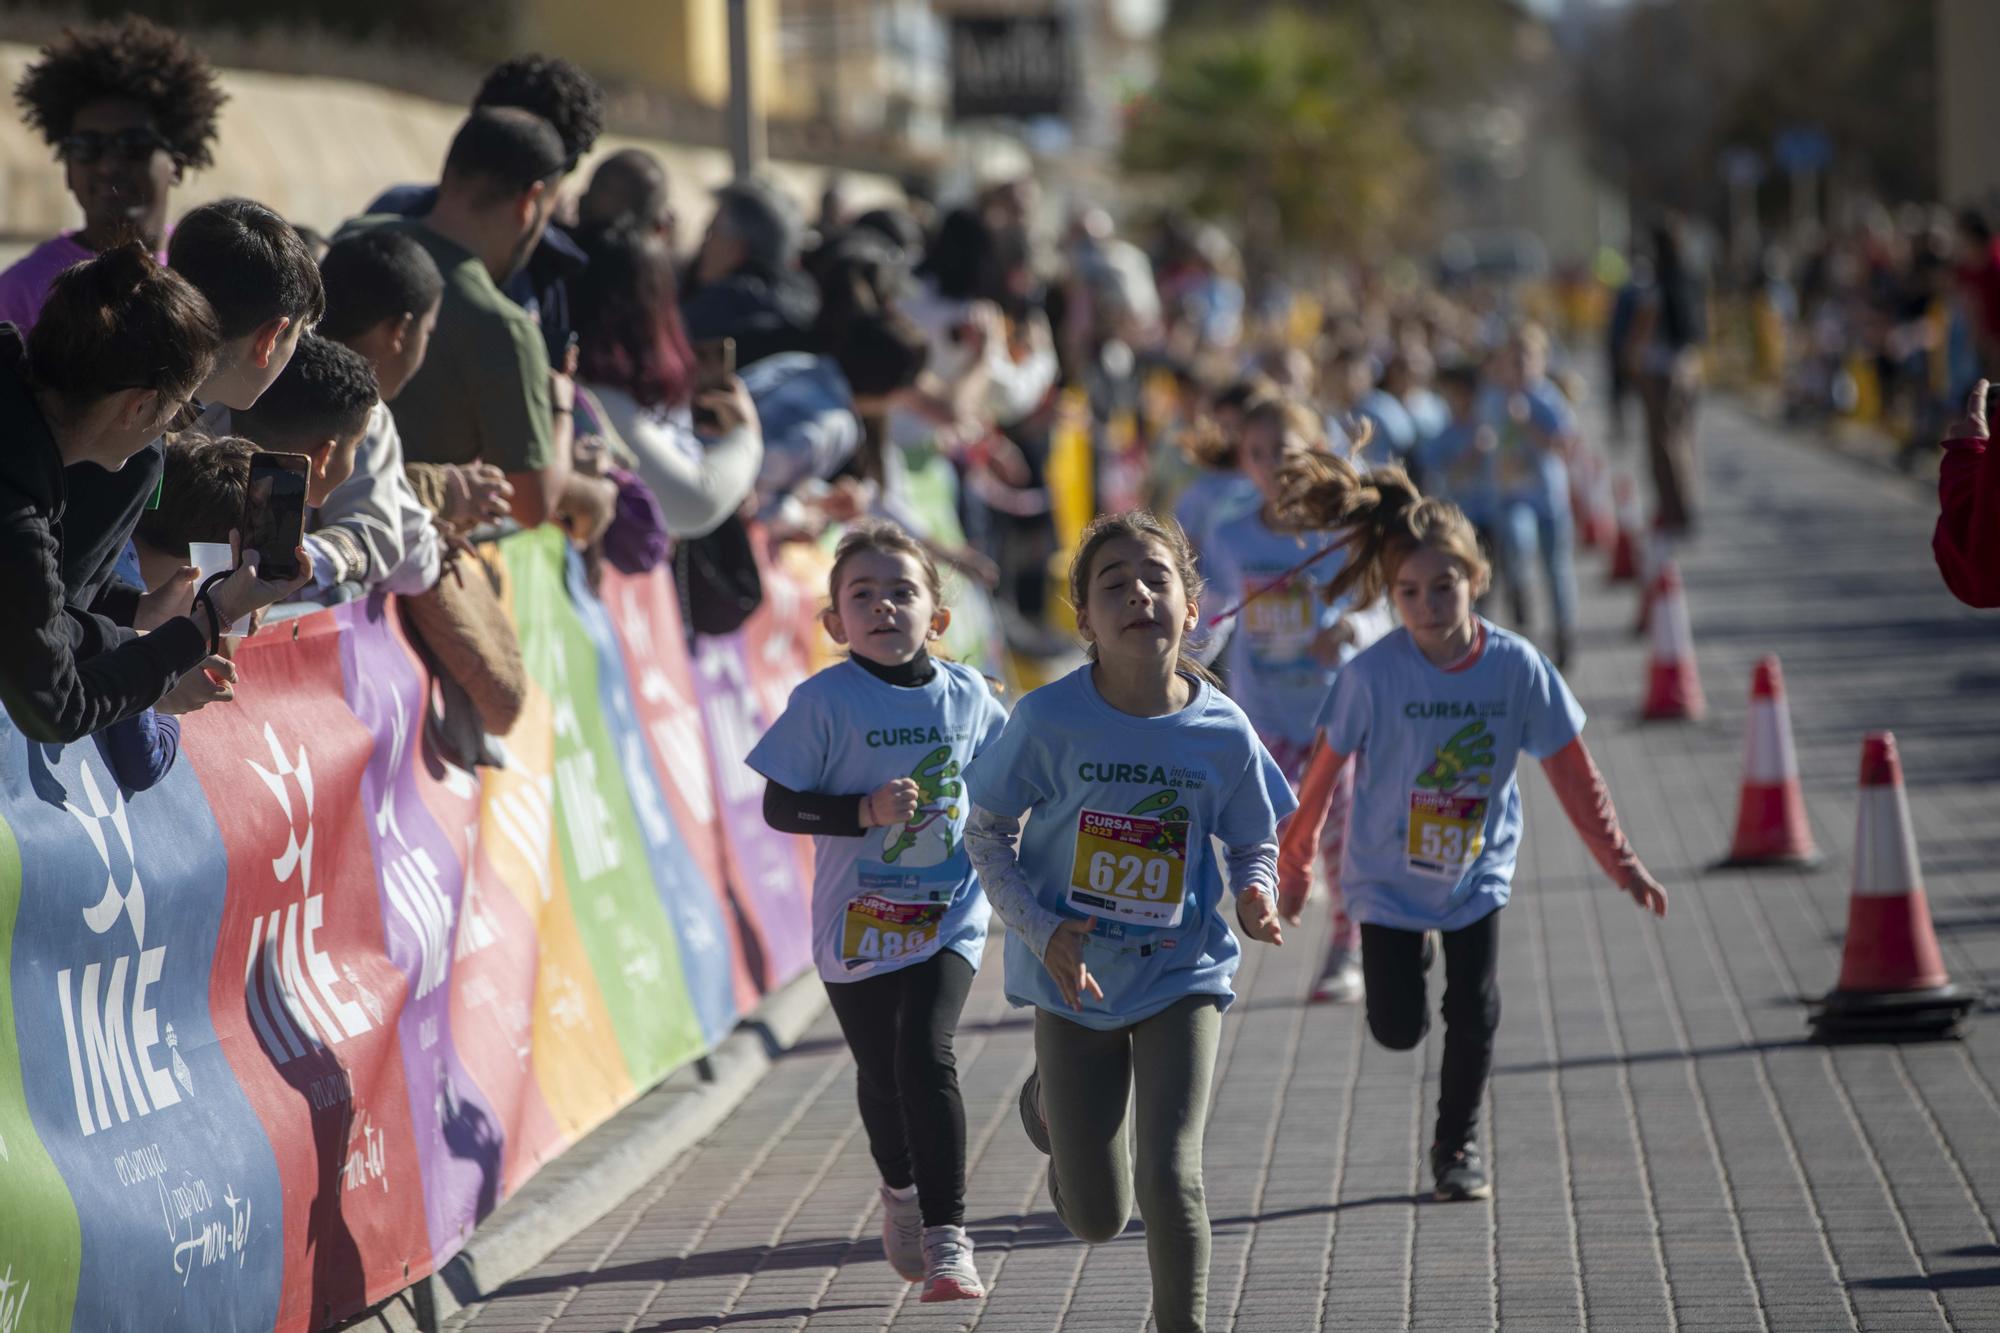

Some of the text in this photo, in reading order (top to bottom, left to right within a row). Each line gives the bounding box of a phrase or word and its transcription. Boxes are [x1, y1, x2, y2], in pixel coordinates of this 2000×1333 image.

[1405, 701, 1477, 719] CURSA
[866, 726, 942, 748] CURSA
[1079, 762, 1168, 786] CURSA
[1169, 778, 1183, 787] de
[1083, 824, 1113, 838] 2023
[1085, 814, 1132, 831] CURSA
[1089, 851, 1170, 900] 629
[245, 893, 373, 1065] IME
[57, 946, 182, 1137] IME
